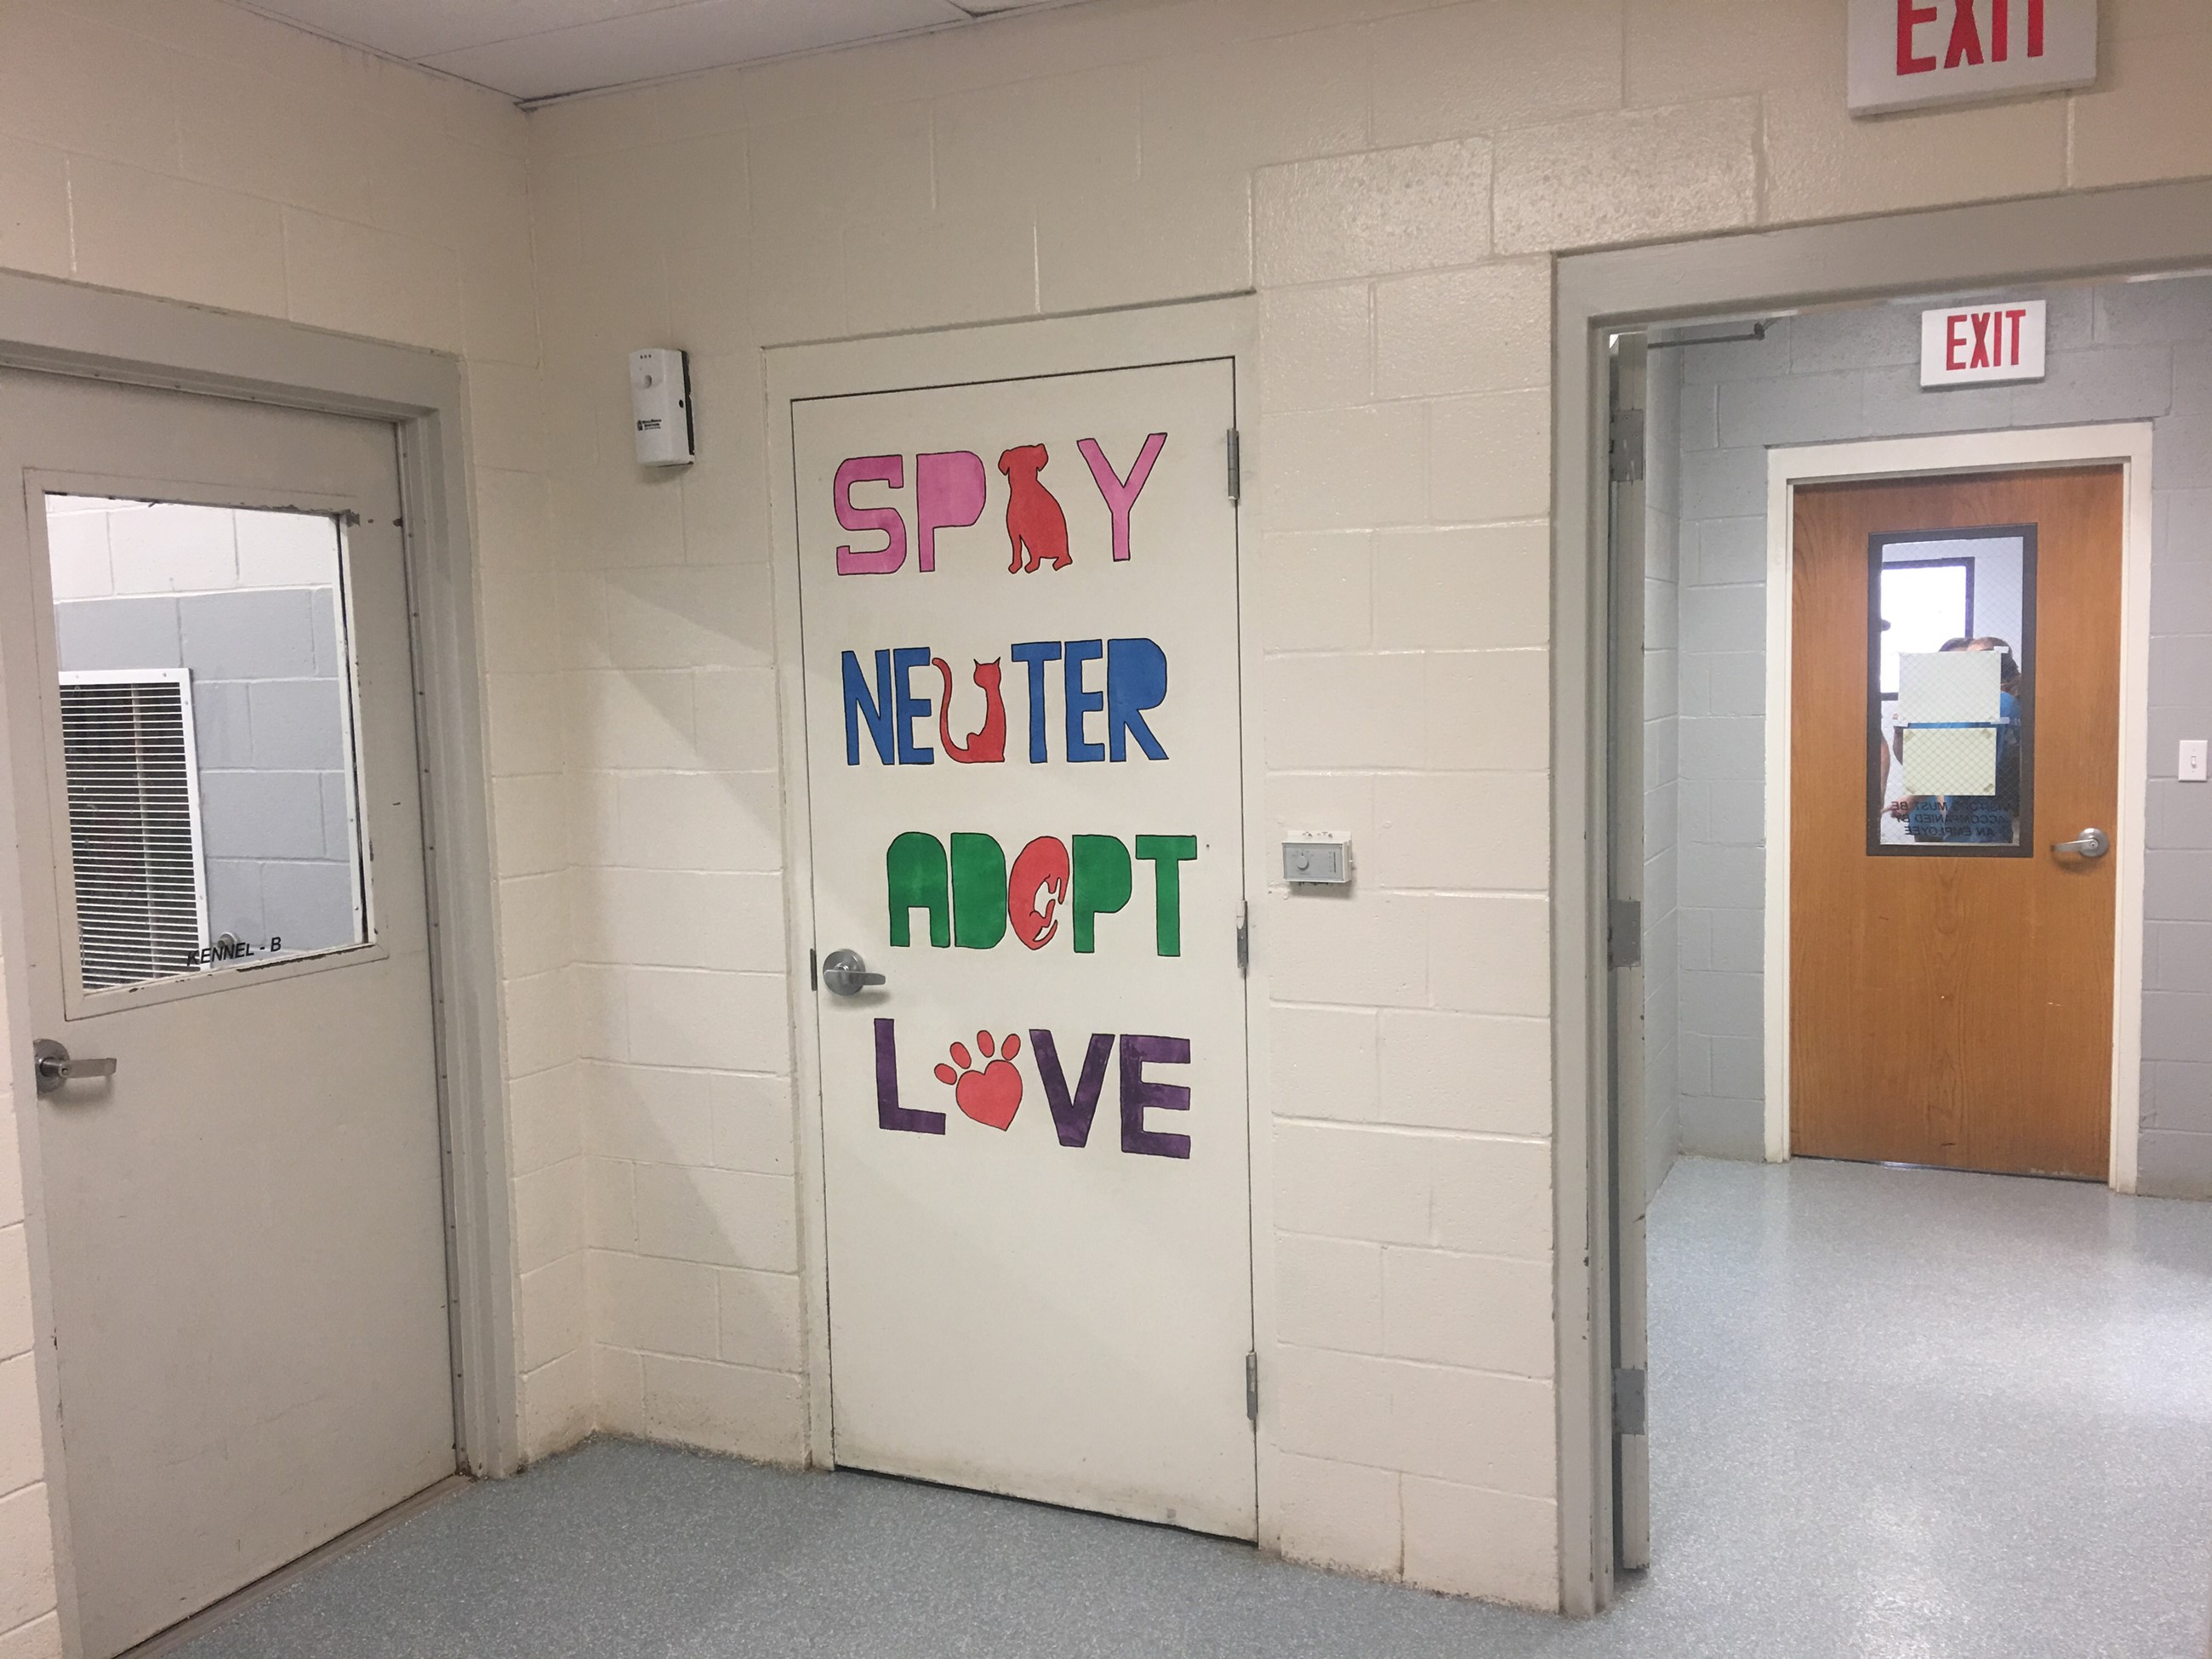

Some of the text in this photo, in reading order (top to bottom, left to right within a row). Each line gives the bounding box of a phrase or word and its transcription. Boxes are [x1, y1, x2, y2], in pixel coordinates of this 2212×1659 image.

[1946, 309, 2026, 371] EXIT
[833, 432, 1168, 575] SPAY
[841, 637, 1170, 766] NEUTER
[187, 943, 254, 966] KENNEL
[271, 937, 282, 952] B
[887, 831, 1198, 957] ADOPT
[874, 1018, 1191, 1160] LOVE
